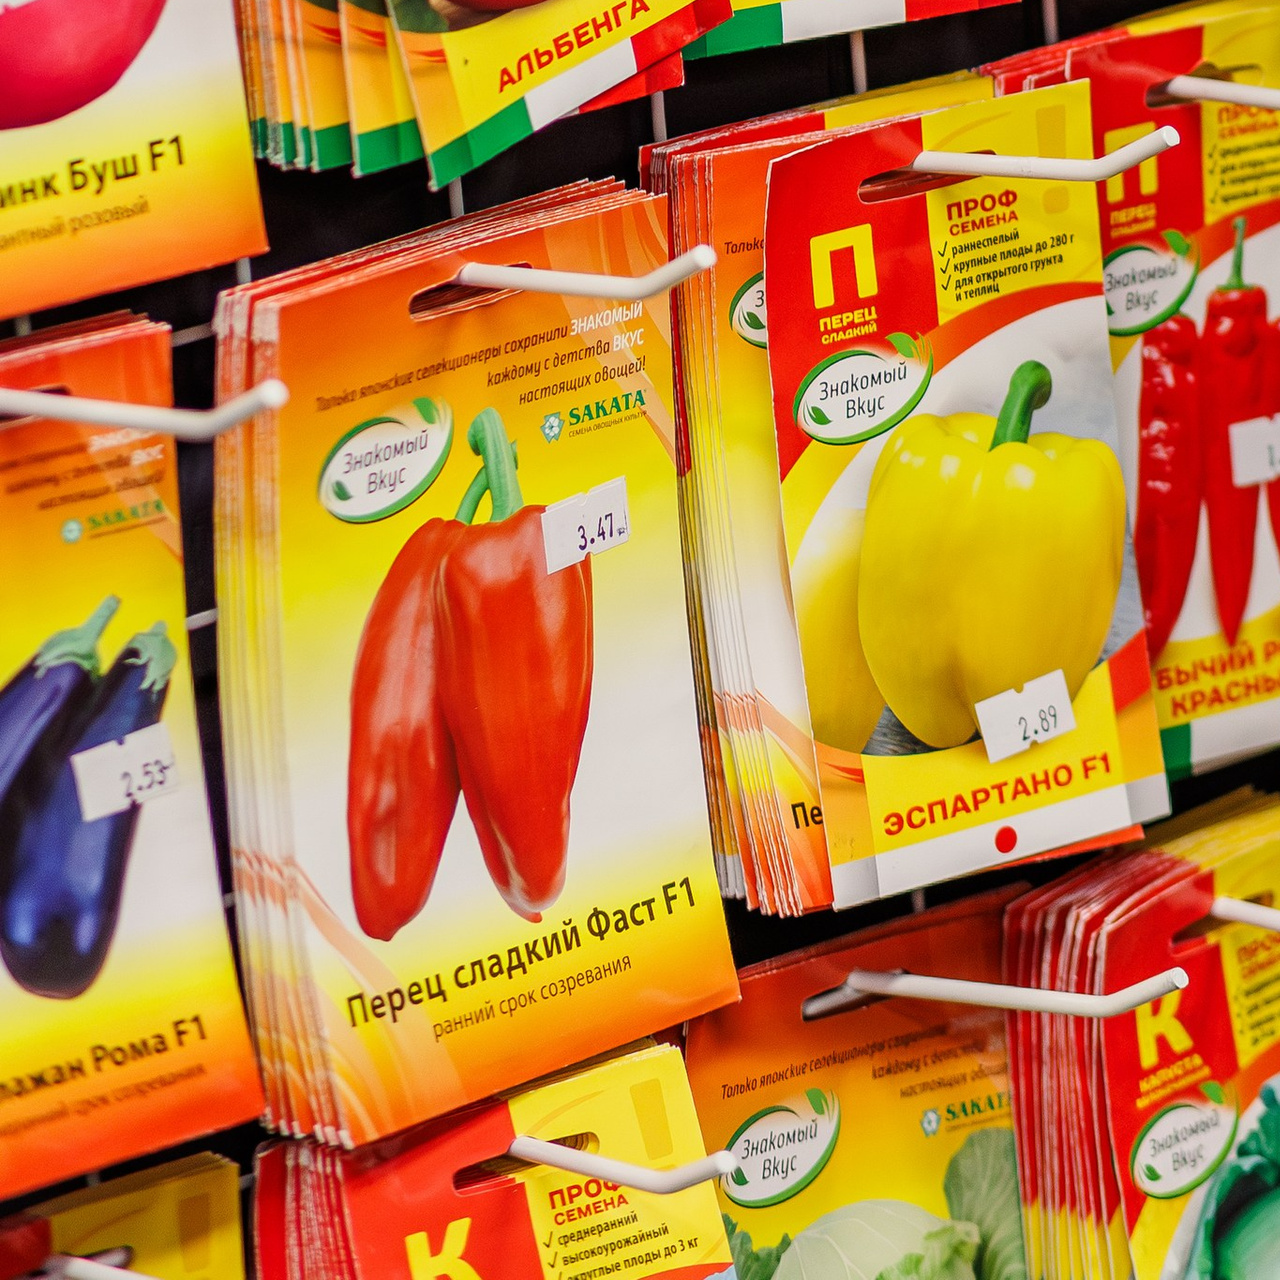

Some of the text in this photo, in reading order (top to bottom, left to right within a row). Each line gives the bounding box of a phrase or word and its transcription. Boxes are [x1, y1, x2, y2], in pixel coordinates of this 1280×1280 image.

[67, 134, 186, 196] Буш F1
[946, 189, 1019, 222] ПРОФ
[948, 210, 1019, 237] СЕМЕНА
[951, 227, 1021, 259] раннеспелый
[953, 243, 1034, 273] крупные плоды
[809, 223, 879, 310] П
[954, 252, 1064, 292] для открытого грунта
[1103, 258, 1179, 292] Знакомый
[962, 282, 1001, 300] теплиц
[818, 306, 878, 332] ПЕРЕЦ
[820, 321, 878, 345] СЛАДКИЙ
[415, 301, 644, 381] селекционеры сохранили ЗНАКОМЫЙ
[486, 328, 645, 388] каждому детства ВКУС
[518, 355, 647, 406] настоящих овощей!
[818, 362, 908, 402] Знакомый
[568, 389, 647, 428] SAKATA
[845, 395, 886, 419] Вкус
[342, 429, 429, 475] Знакомый
[366, 466, 407, 496] Вкус
[577, 511, 615, 551] 3.47
[1156, 642, 1257, 691] БЫЧИЙ
[1018, 705, 1059, 742] 2.89
[883, 764, 1073, 836] ЭСПАРТАНО
[1082, 751, 1111, 780] F1
[345, 877, 697, 1028] Перец сладкий Фаст F1
[432, 953, 633, 1042] ранний срок созревания
[91, 1012, 209, 1074] Рома F1
[720, 1061, 809, 1101] Только японские
[741, 1117, 819, 1161] Знакомый
[1148, 1108, 1222, 1159] Знакомый
[762, 1154, 798, 1181] Вкус
[554, 1193, 630, 1227] СЕМЕНА
[557, 1210, 640, 1248] среднеранний
[562, 1222, 671, 1268] высокоурожайный
[623, 1248, 663, 1271] плоды
